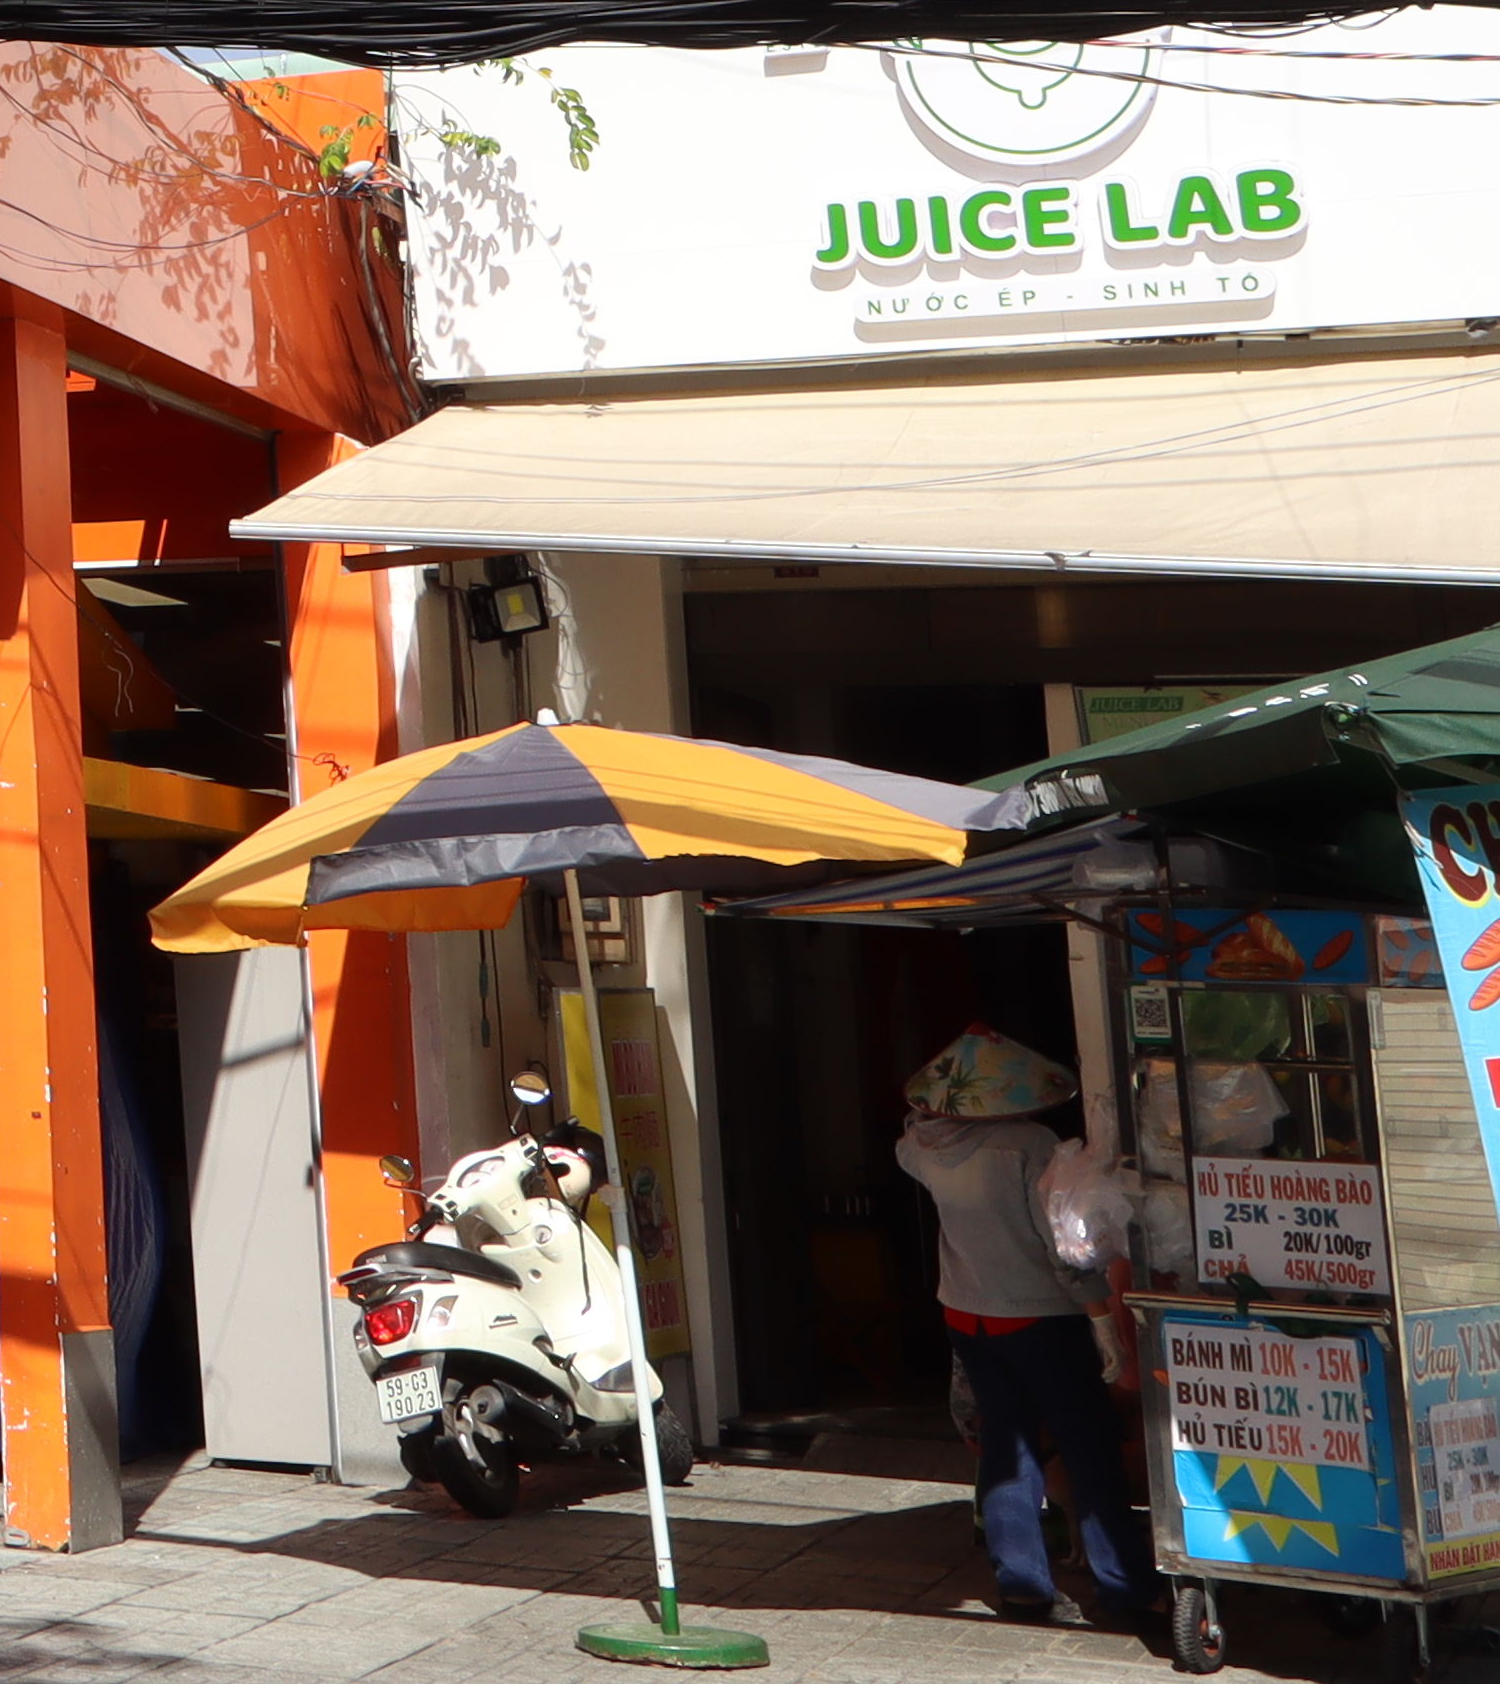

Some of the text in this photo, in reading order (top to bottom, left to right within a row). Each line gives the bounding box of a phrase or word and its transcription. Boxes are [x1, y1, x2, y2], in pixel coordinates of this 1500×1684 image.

[814, 166, 1303, 265] JUICE LAB
[866, 268, 1261, 318] NƯỚC ÉP SINH TỐ
[1224, 1164, 1374, 1206] TIẾU HOÀNG BÀO
[1208, 1225, 1233, 1251] BÌ
[1224, 1202, 1341, 1229] 25K 30K
[1171, 1331, 1357, 1384] BÁNH MÌ 10K 15K
[1411, 1318, 1461, 1402] Chay
[386, 1369, 429, 1398] 59-G3
[386, 1390, 436, 1420] 190.23
[1175, 1376, 1360, 1425] BÚN BÌ 12K 17K
[1177, 1412, 1363, 1465] HỦ TIẾU 15K 20K
